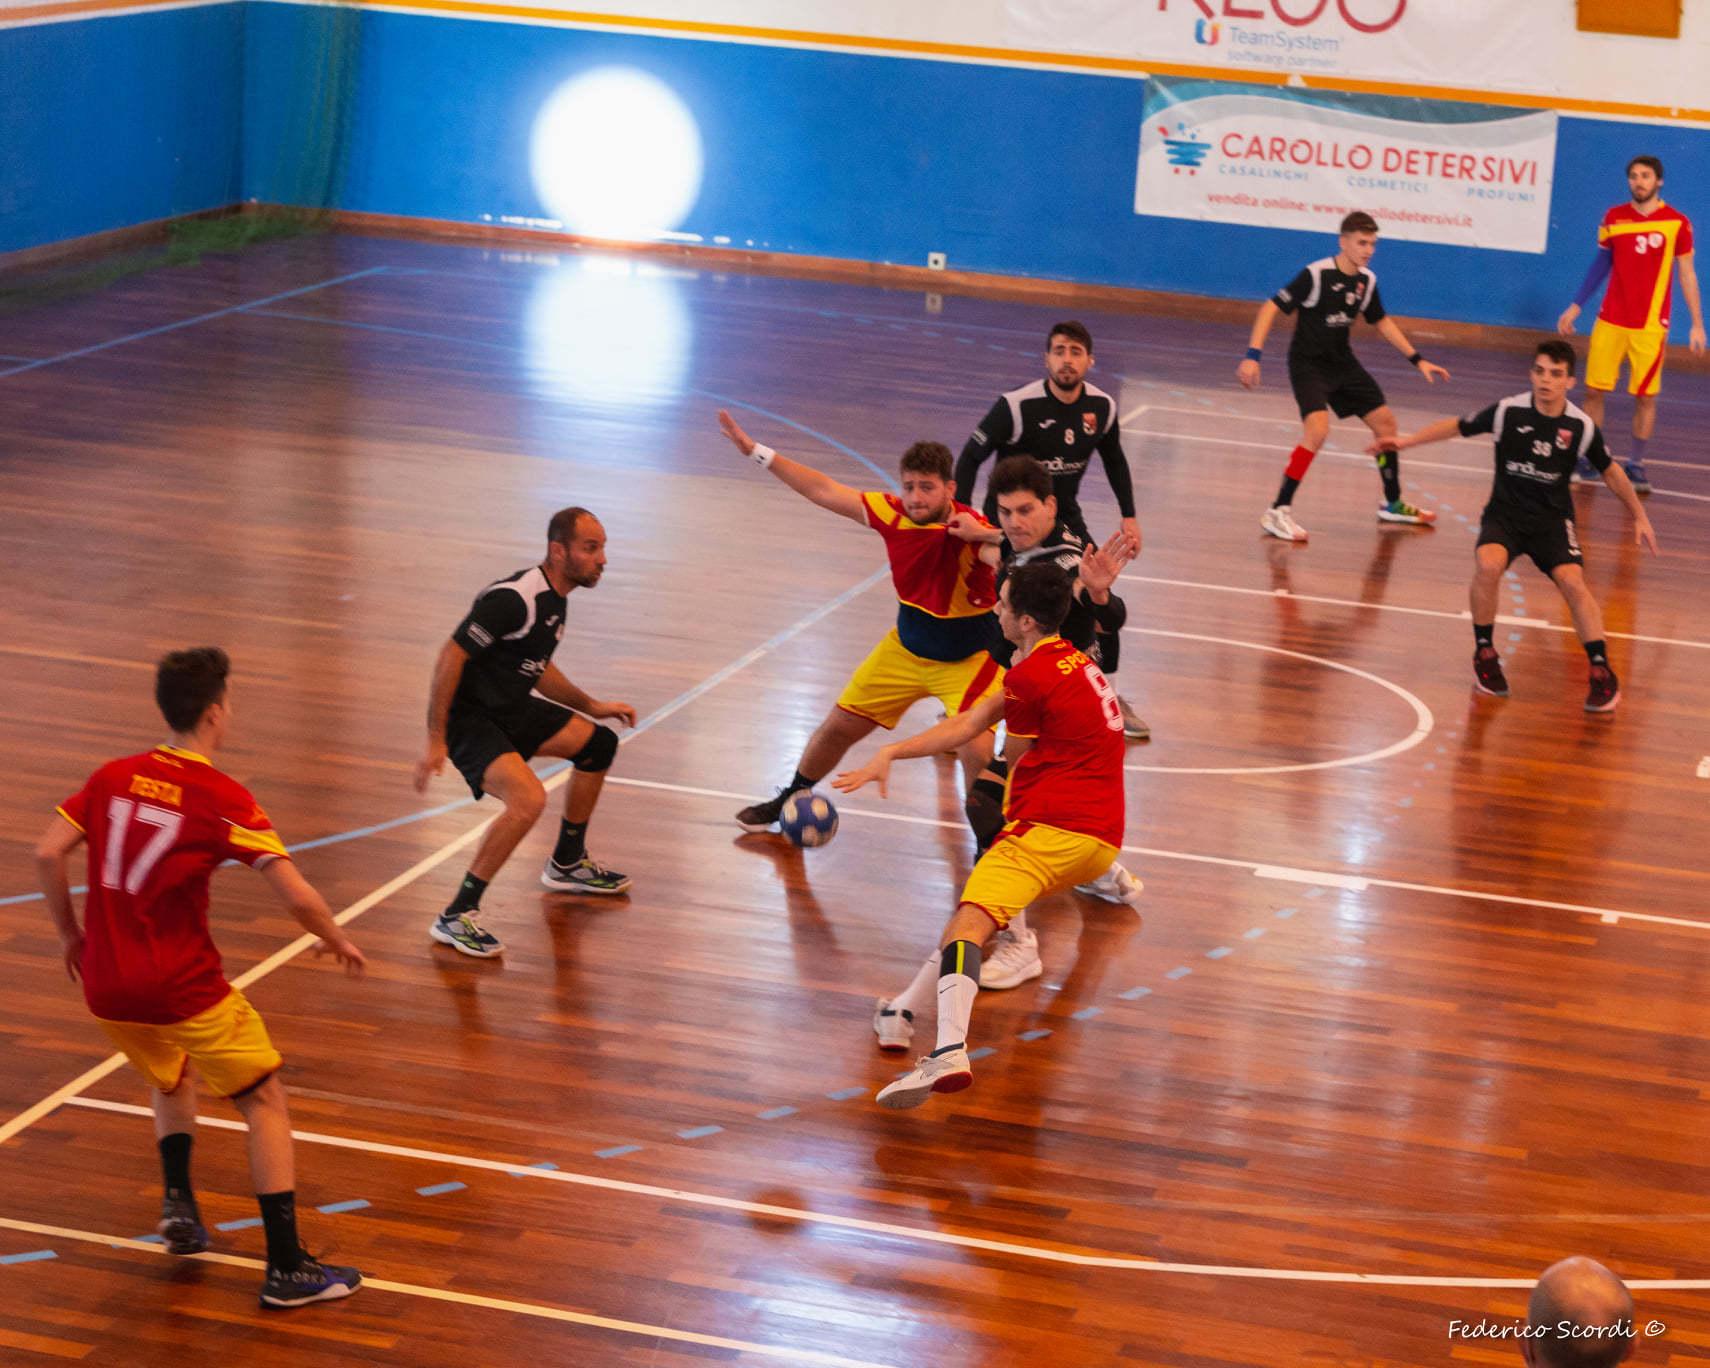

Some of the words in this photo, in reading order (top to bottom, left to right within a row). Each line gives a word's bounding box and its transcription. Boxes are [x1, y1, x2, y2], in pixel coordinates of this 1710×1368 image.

[1229, 26, 1339, 52] TeamSystem
[1221, 132, 1373, 170] CAROLLO
[1382, 147, 1537, 186] DETERSIVI
[1218, 163, 1309, 182] CASALINGHI
[1347, 176, 1429, 194] COSMETICI
[1466, 187, 1536, 203] PROFUMI
[1207, 192, 1259, 208] vendita
[1262, 197, 1309, 212] online:
[1064, 428, 1075, 446] 8
[1532, 439, 1553, 458] 38
[1083, 663, 1125, 732] 8
[100, 795, 186, 895] 17
